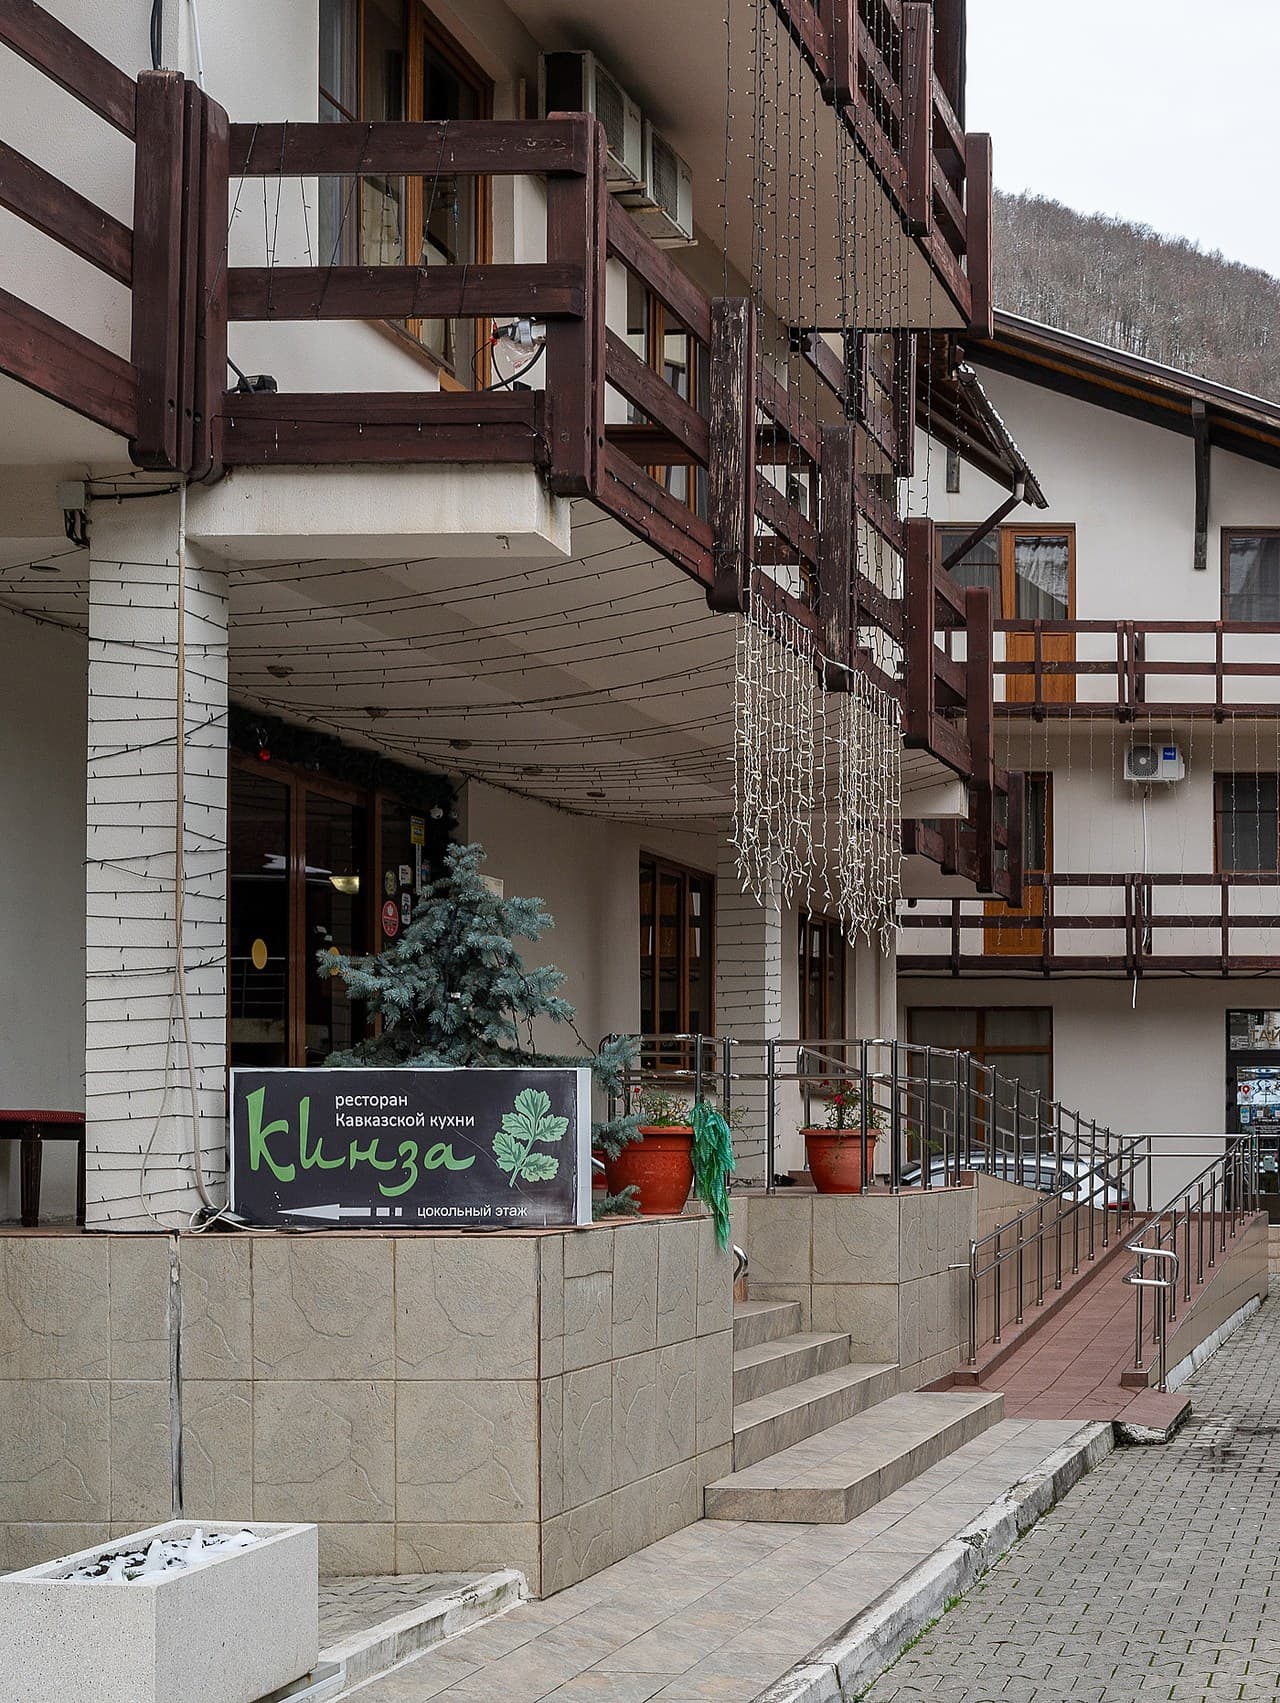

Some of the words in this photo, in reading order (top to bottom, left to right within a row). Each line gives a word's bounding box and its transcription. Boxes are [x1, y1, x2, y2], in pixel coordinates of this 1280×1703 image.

[336, 1094, 408, 1109] ресторан
[335, 1113, 425, 1127] Кавказской
[430, 1115, 475, 1129] кухни
[246, 1086, 476, 1197] Кинза
[417, 1206, 492, 1218] цокольный
[495, 1205, 528, 1217] этаж
